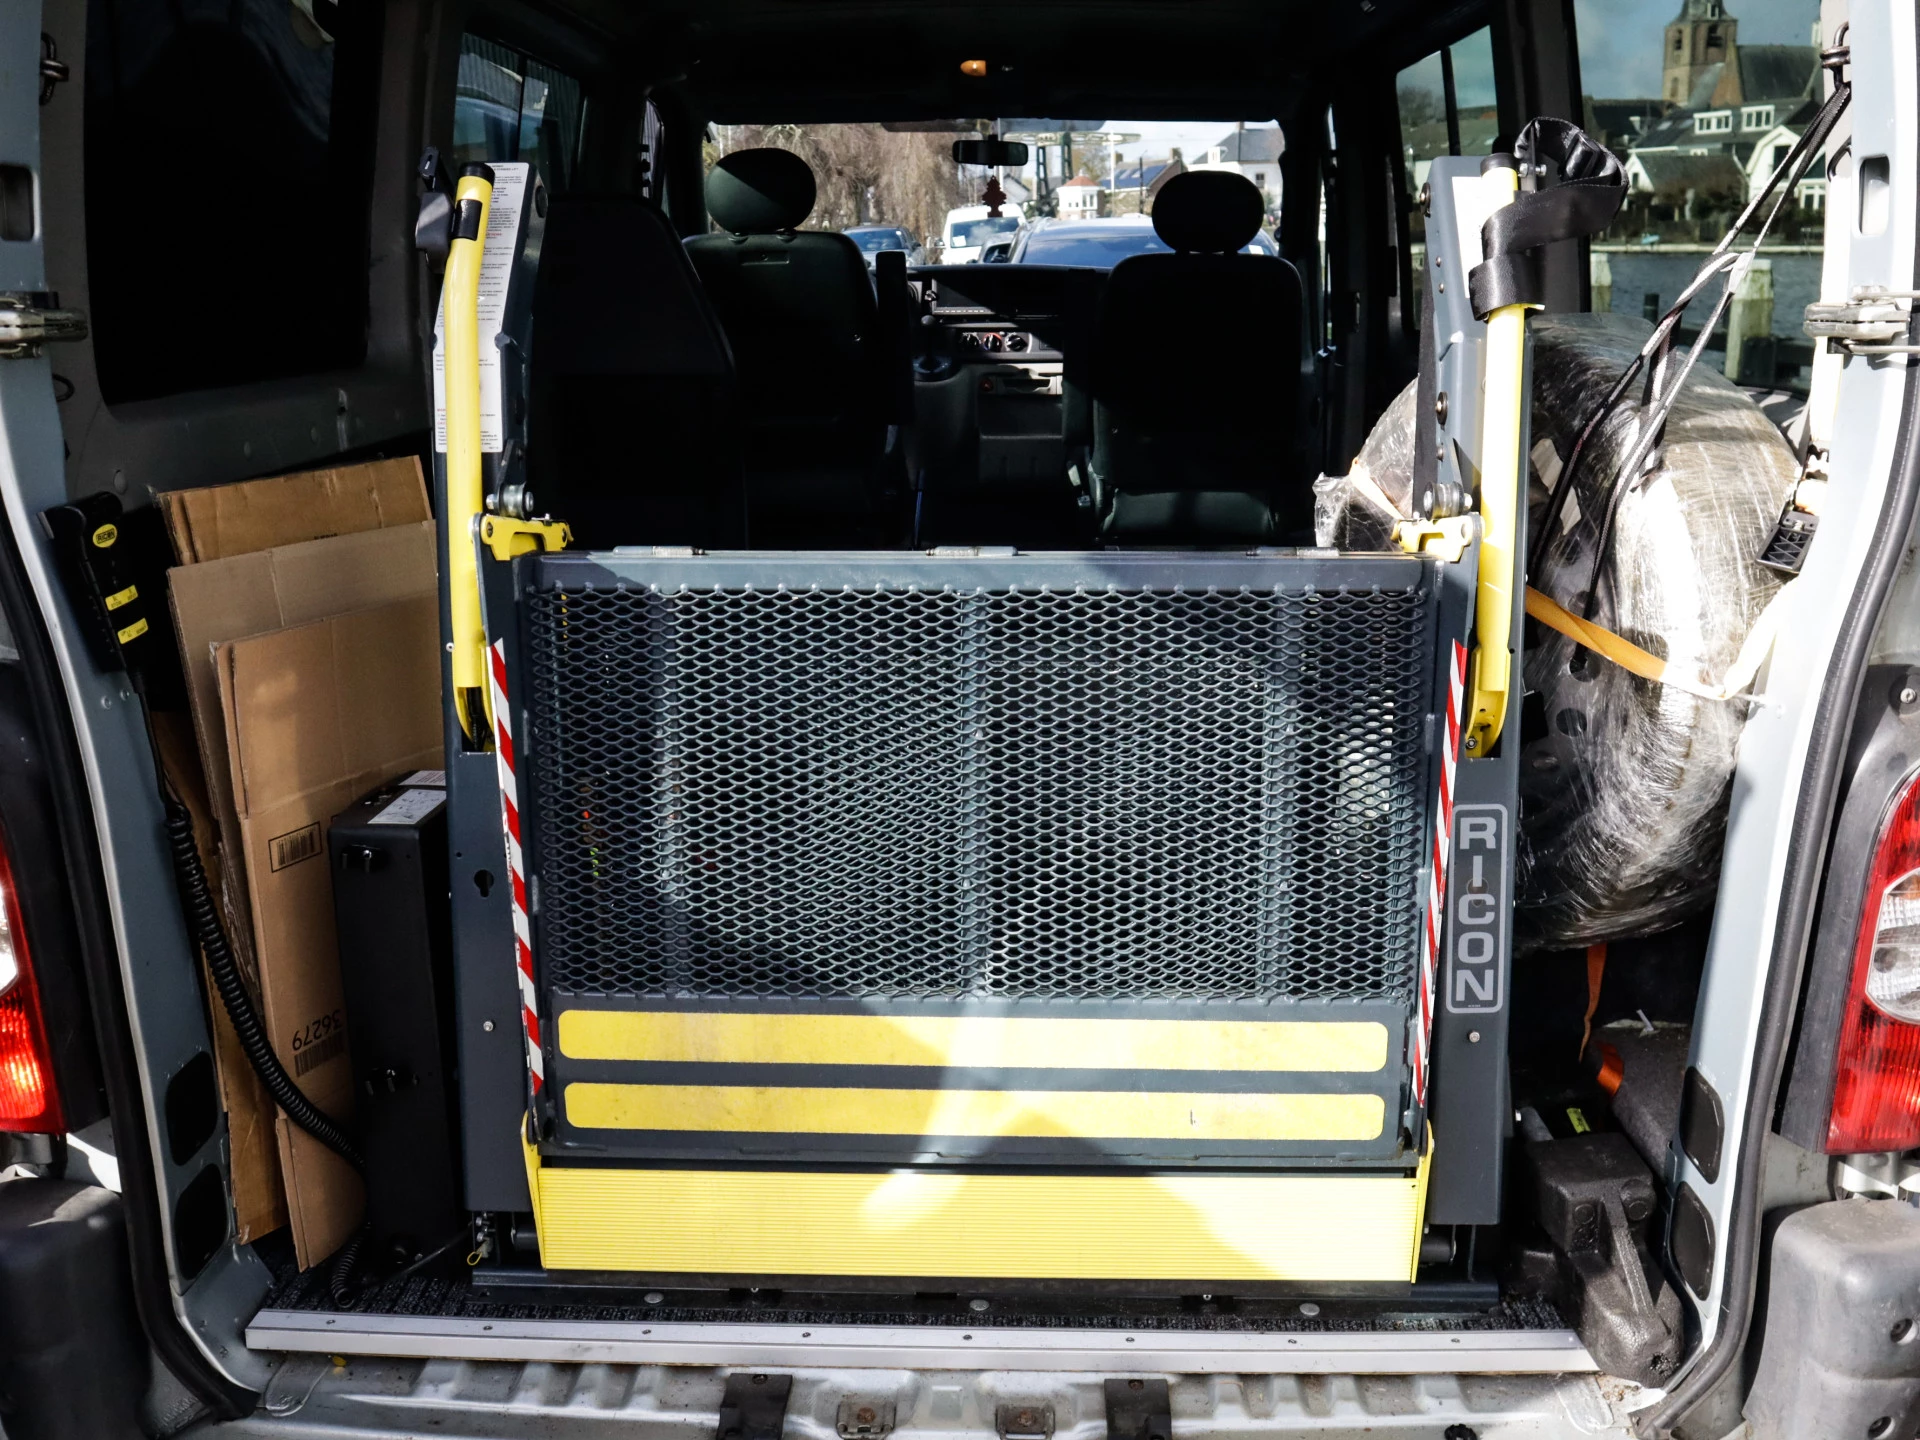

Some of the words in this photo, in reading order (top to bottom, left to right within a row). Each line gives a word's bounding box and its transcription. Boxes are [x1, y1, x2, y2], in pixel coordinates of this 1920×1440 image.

[97, 529, 115, 543] RICON
[1456, 816, 1497, 1001] RICON
[292, 1008, 342, 1051] 36279
